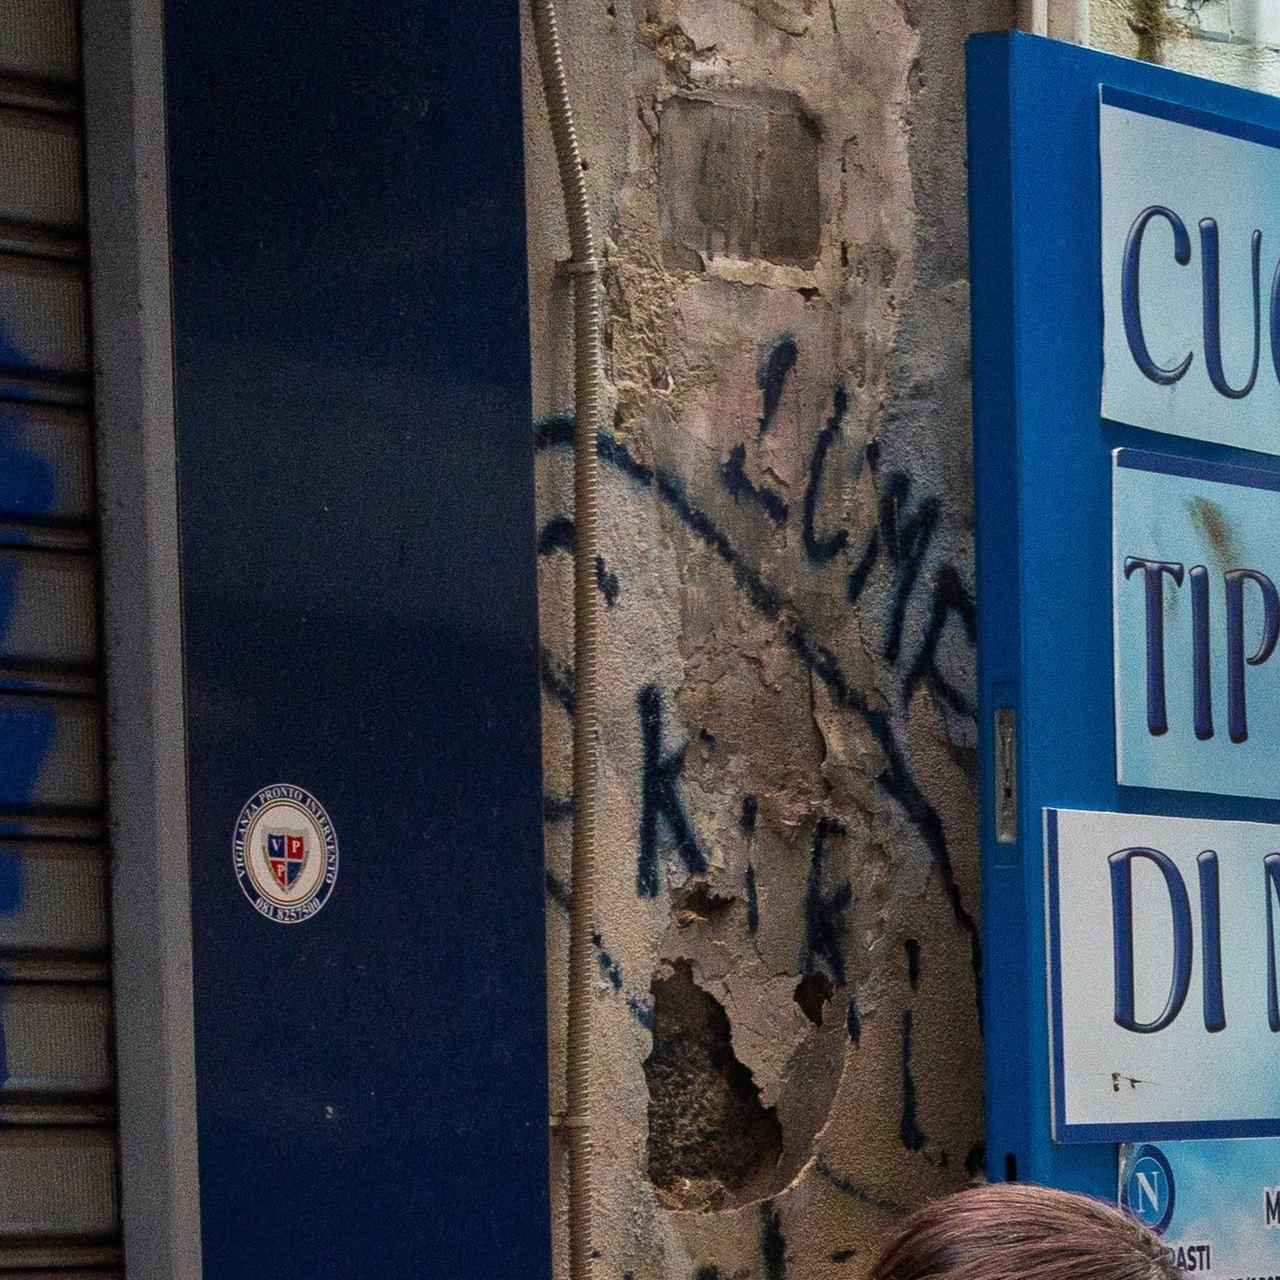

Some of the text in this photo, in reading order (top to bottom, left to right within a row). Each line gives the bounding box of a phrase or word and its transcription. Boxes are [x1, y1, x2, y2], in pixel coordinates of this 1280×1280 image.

[235, 787, 337, 884] VIGILANZA PRONTO INTERVENTO
[1108, 847, 1227, 1034] DI
[1136, 1171, 1160, 1213] N
